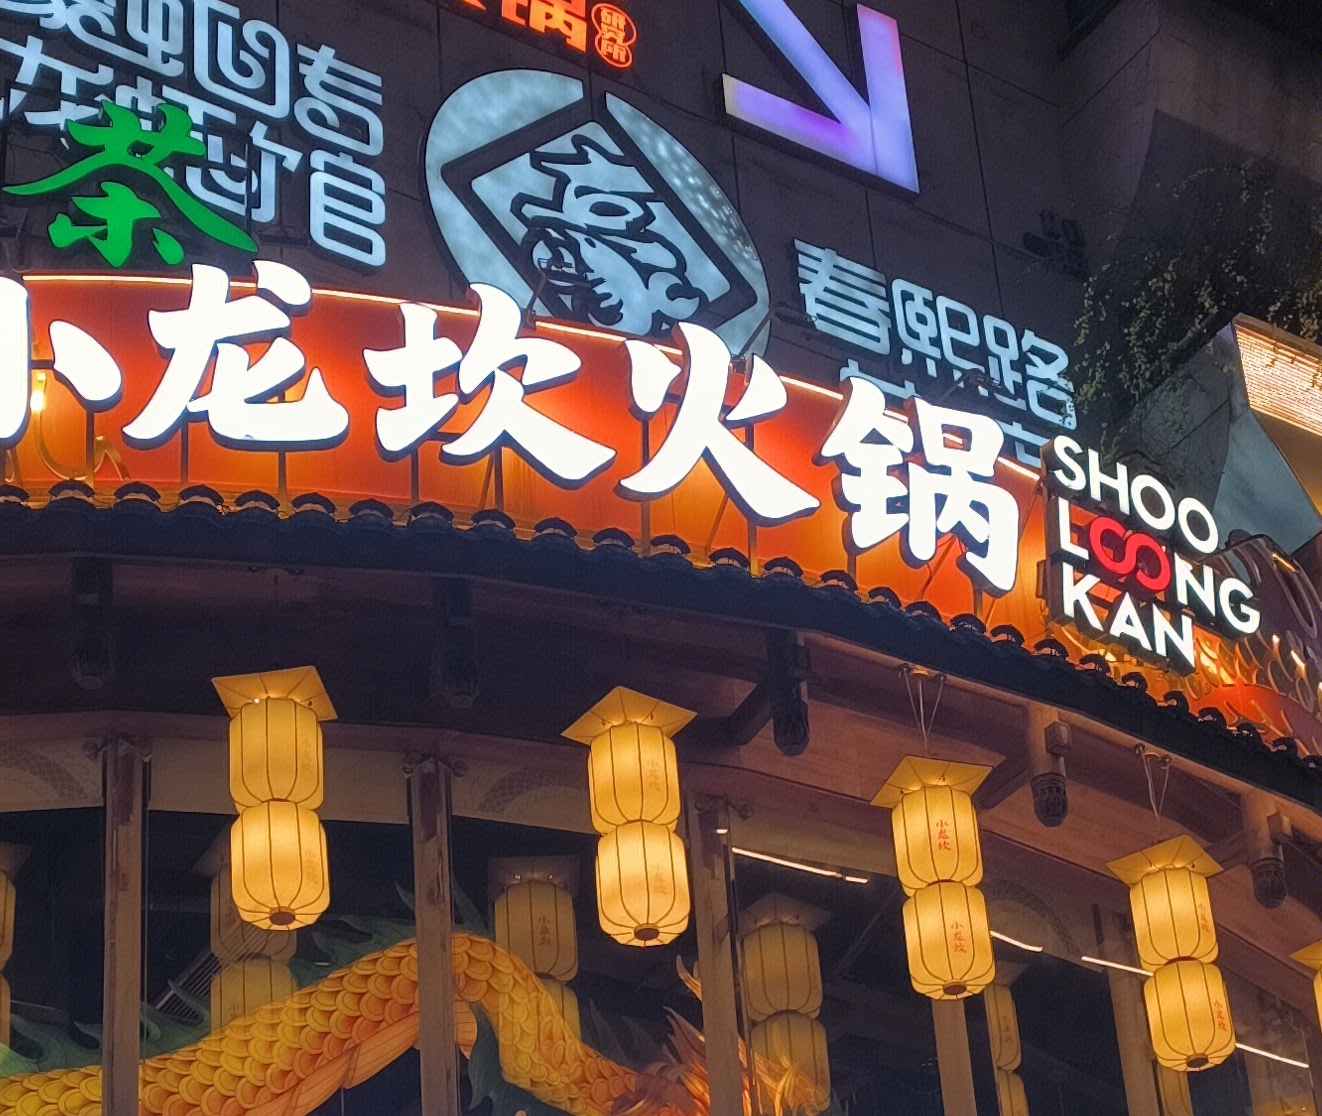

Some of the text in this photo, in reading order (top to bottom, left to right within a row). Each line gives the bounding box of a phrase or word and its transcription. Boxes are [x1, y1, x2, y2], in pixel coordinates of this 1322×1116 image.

[2, 100, 259, 268] 茶
[793, 237, 1078, 430] 春熙路
[1053, 434, 1219, 555] SHOO
[1061, 560, 1196, 676] KAN
